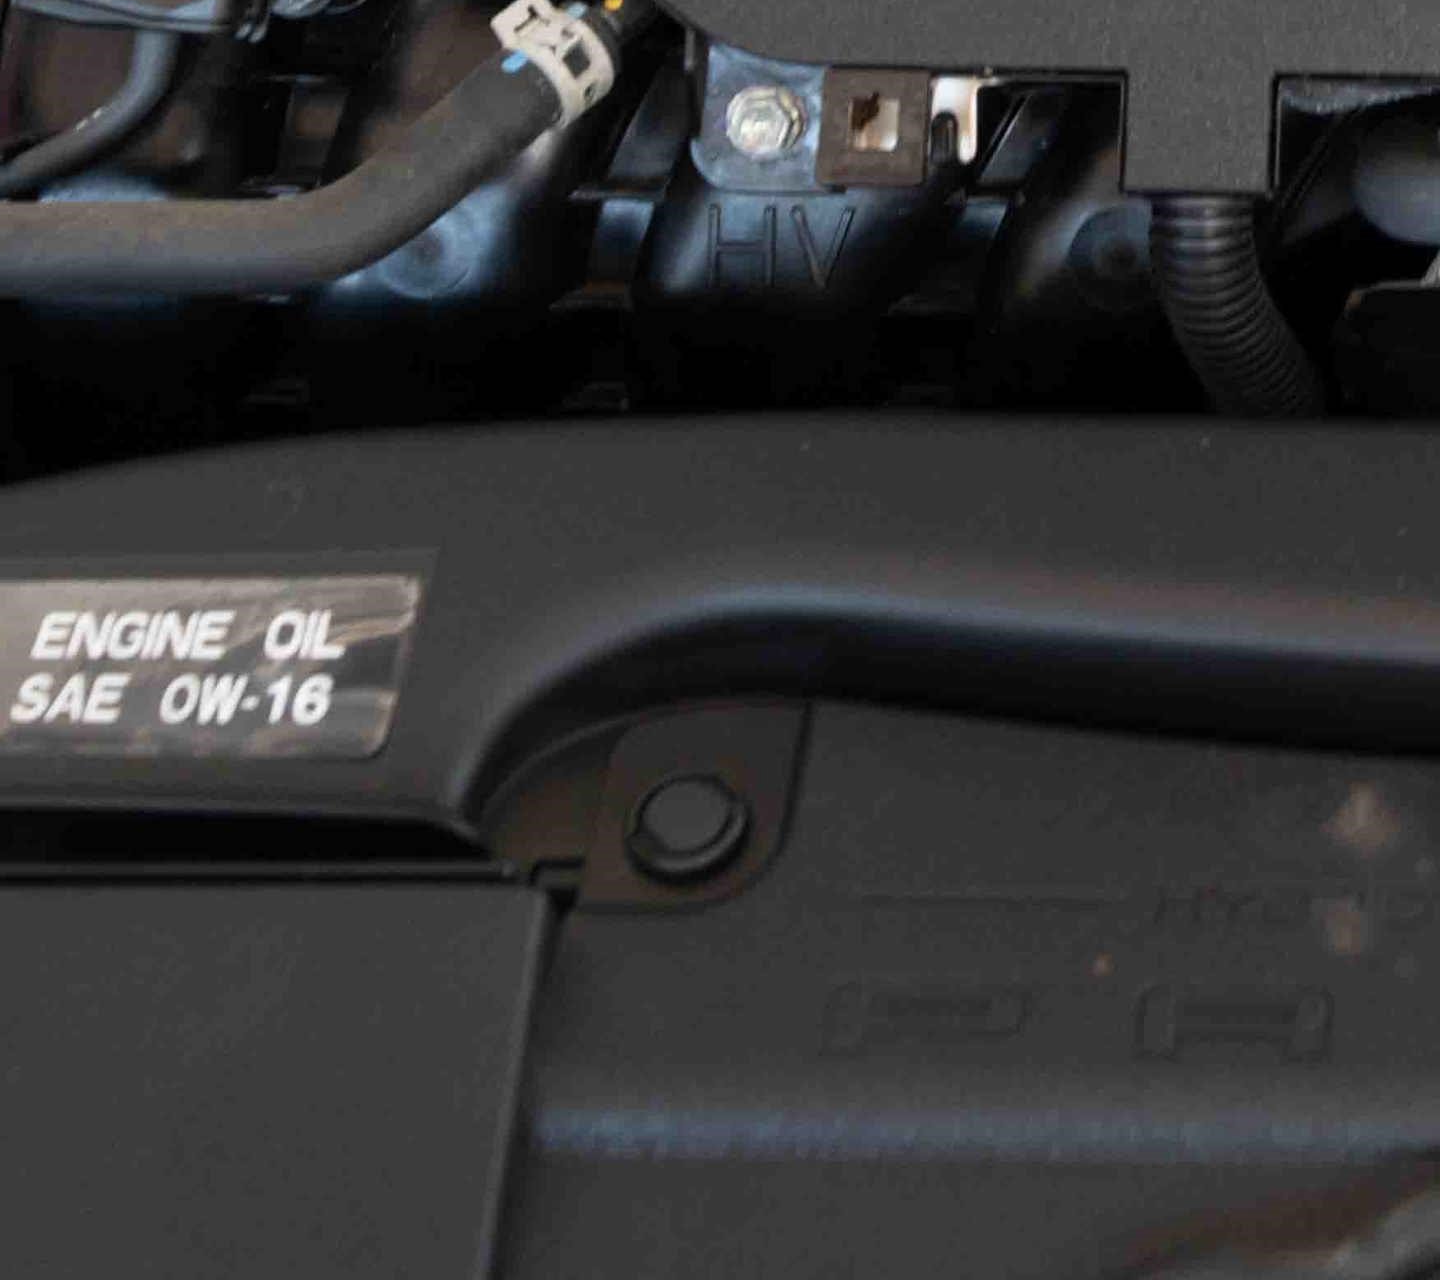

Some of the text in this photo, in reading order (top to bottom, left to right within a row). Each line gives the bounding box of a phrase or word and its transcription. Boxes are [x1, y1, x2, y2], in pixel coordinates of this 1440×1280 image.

[707, 203, 857, 291] HV
[29, 609, 346, 660] ENGINE OIL
[10, 672, 335, 726] SAE 0W-16
